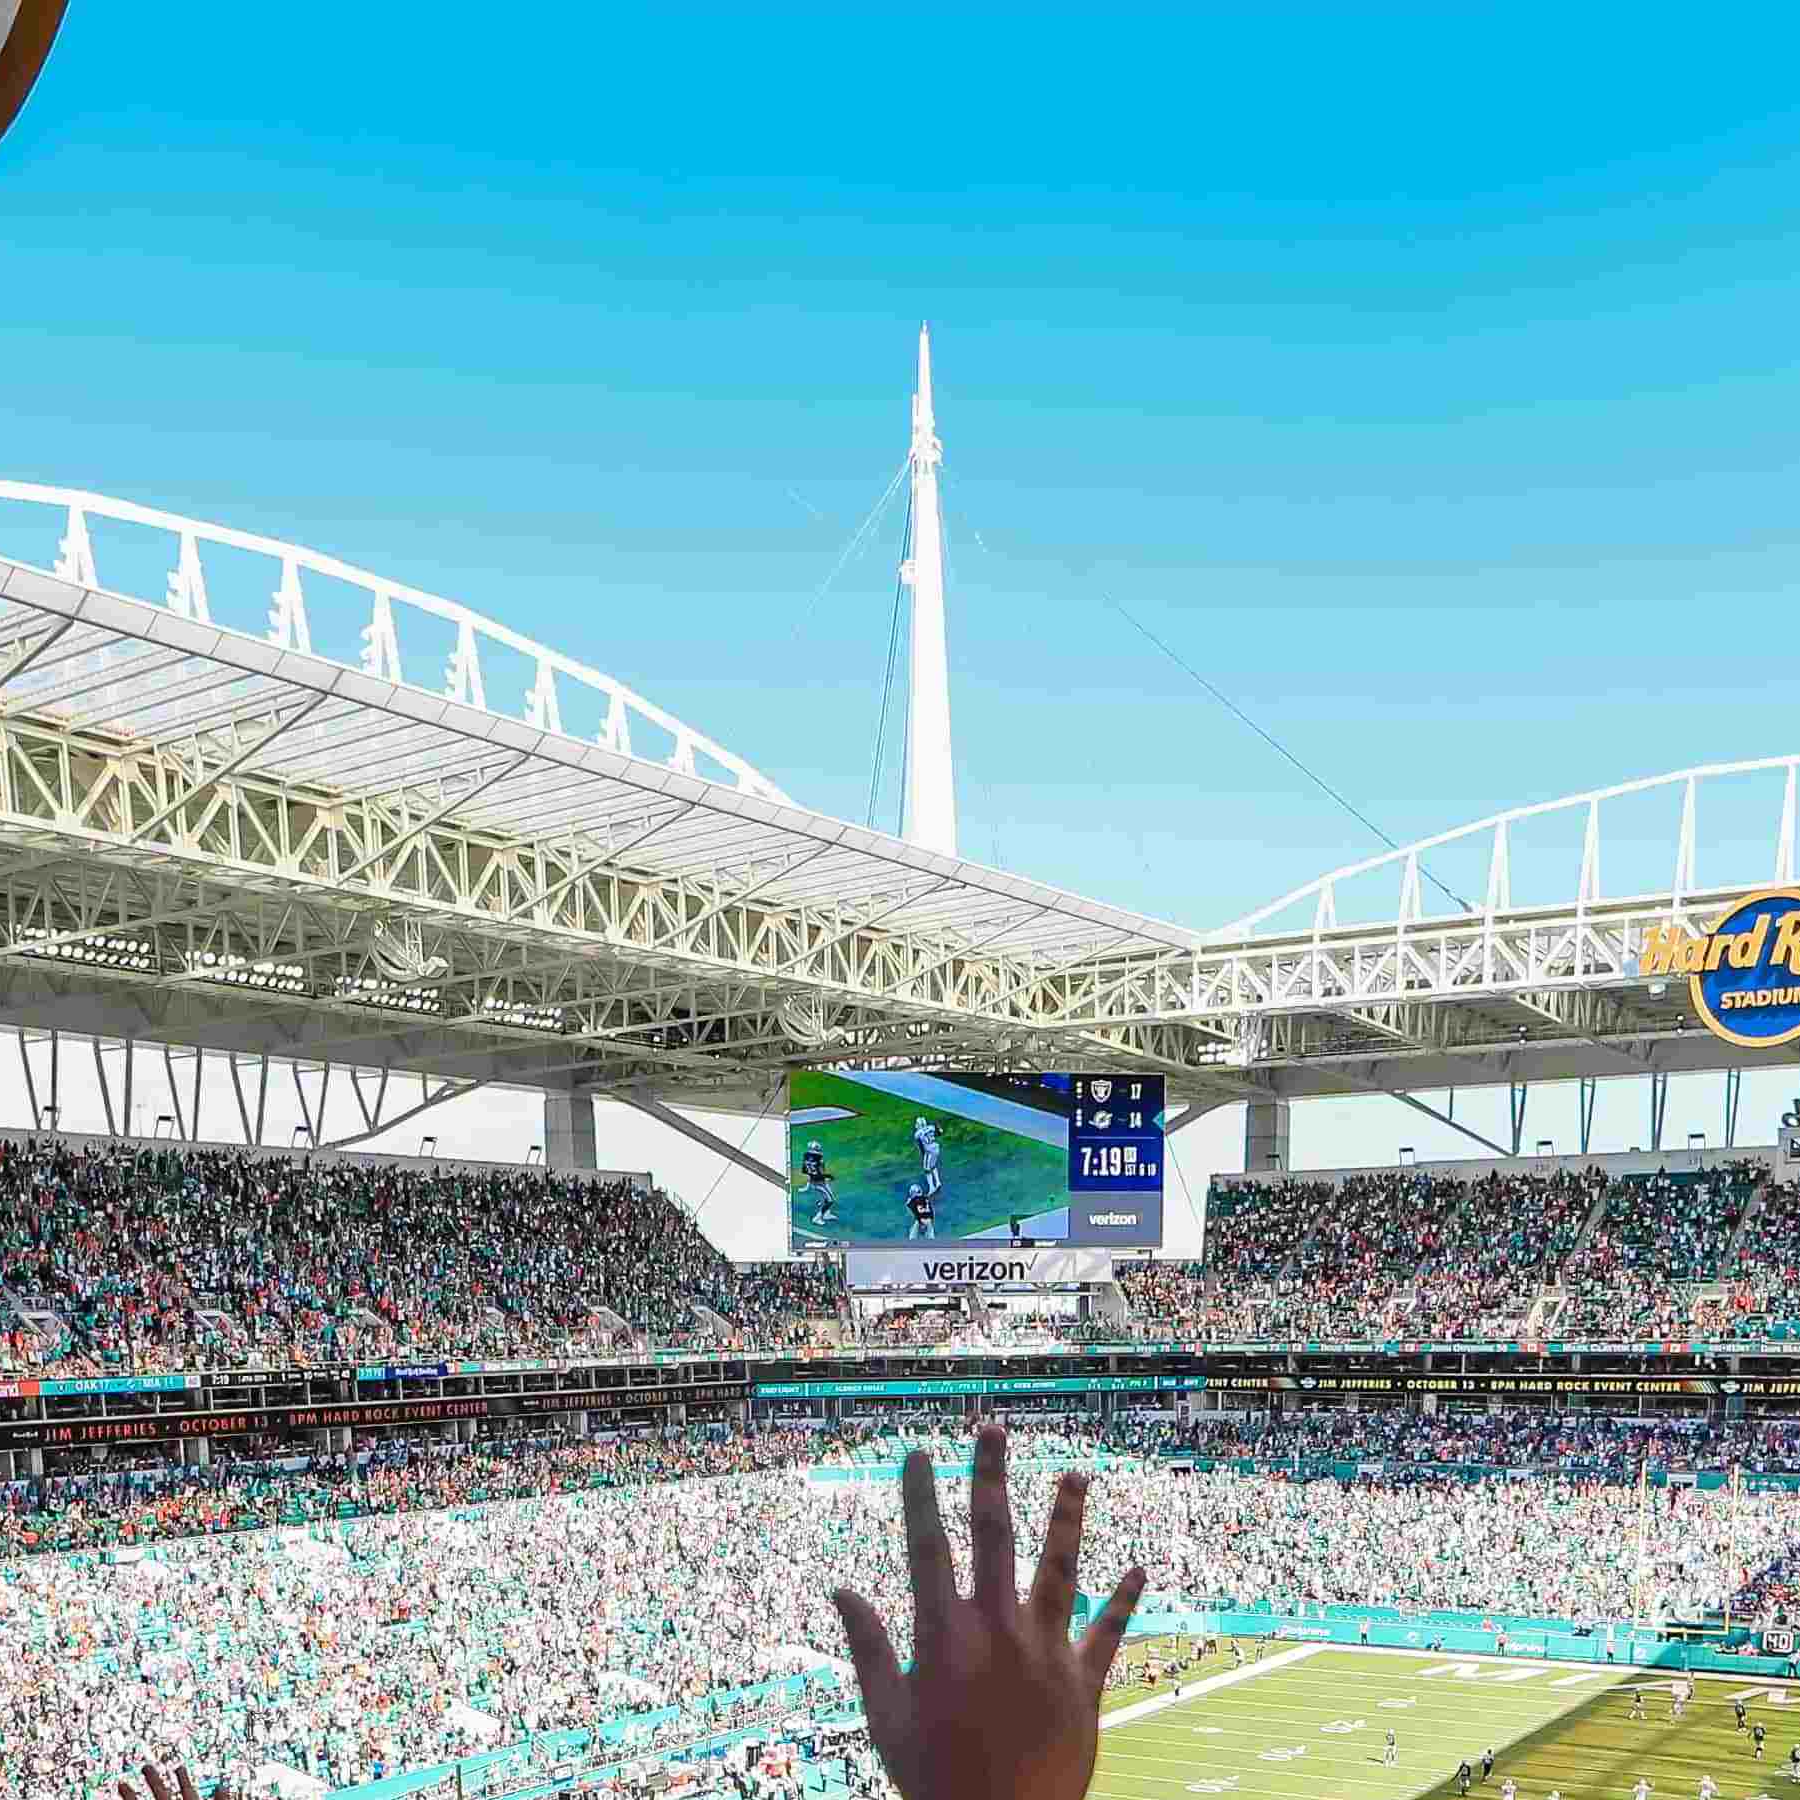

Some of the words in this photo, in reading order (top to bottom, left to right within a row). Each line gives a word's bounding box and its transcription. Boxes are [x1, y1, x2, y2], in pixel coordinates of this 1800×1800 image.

[1639, 913, 1766, 977] Hard
[1130, 1083, 1142, 1100] 17
[1081, 1147, 1121, 1177] 7:19
[1088, 1212, 1138, 1225] verizon
[923, 1256, 1026, 1281] verizon
[1406, 1380, 1458, 1390] OCTOBER
[1520, 1381, 1553, 1391] HARD
[1556, 1381, 1590, 1391] ROCK
[1594, 1382, 1632, 1391] EVENT
[1637, 1382, 1681, 1392] CENTER
[1741, 1384, 1765, 1394] JIM
